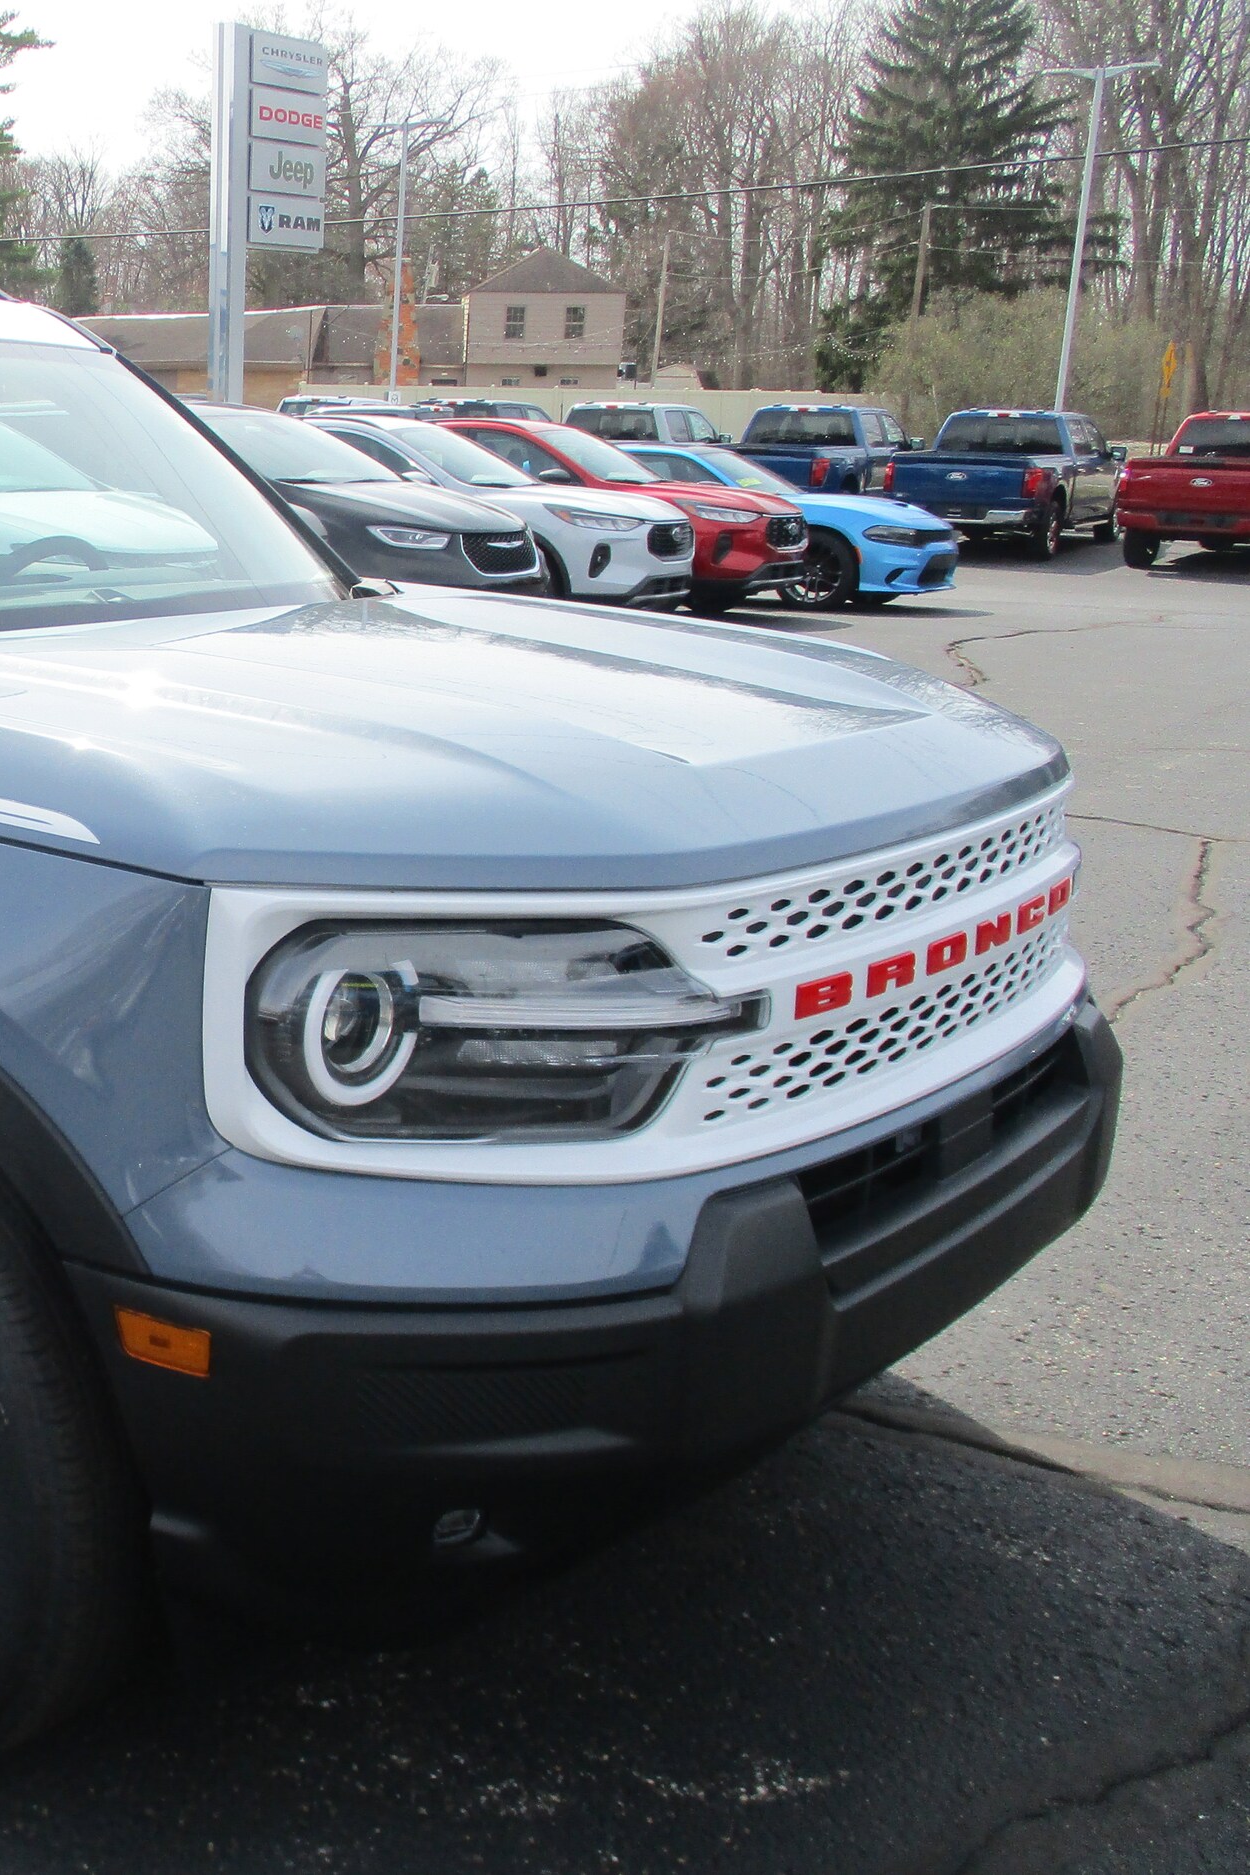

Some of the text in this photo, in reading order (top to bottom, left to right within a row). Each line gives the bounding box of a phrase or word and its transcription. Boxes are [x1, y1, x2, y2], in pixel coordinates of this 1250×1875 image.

[262, 46, 323, 65] CHRYSLER
[259, 105, 323, 130] DODGE
[269, 150, 314, 189] Jeep
[278, 213, 321, 232] RAM
[794, 876, 1073, 1021] BRONCO
